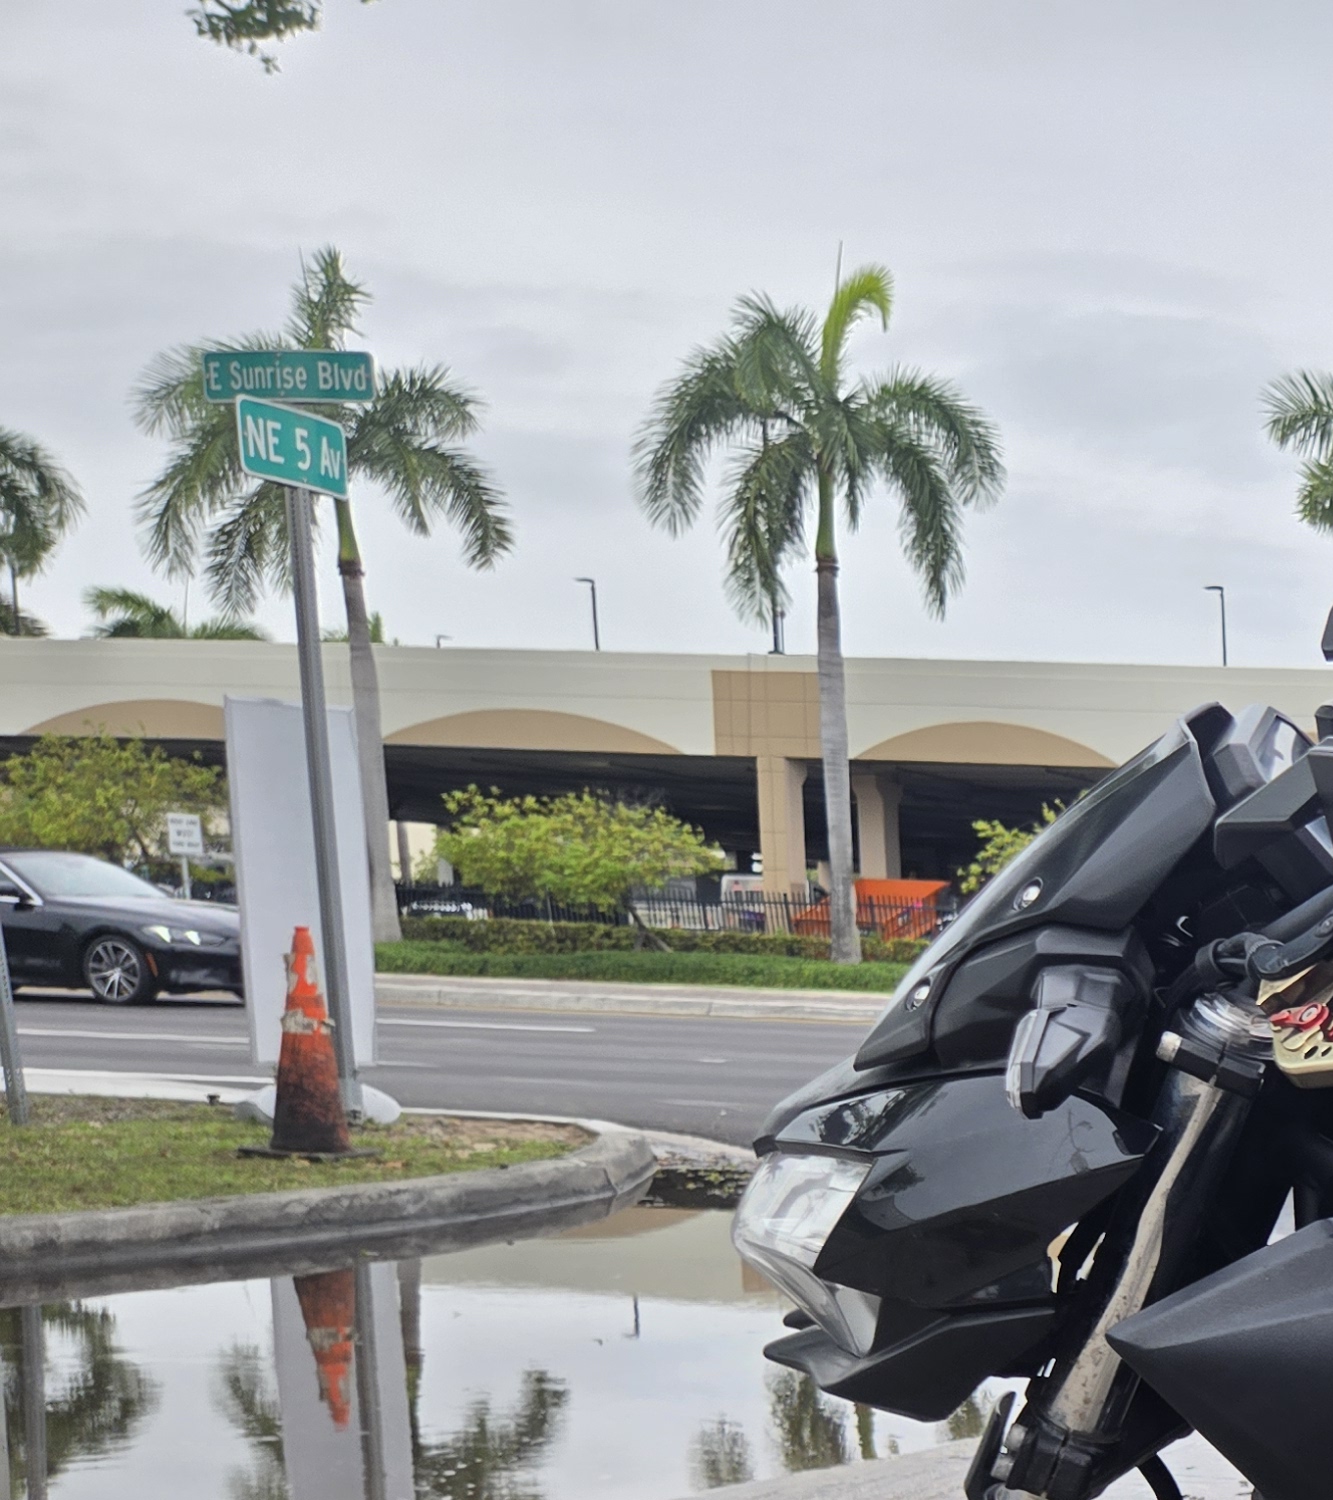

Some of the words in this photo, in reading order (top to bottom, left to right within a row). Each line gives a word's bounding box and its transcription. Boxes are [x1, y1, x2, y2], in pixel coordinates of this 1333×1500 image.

[208, 361, 222, 391] E
[230, 360, 308, 391] Sunrise
[317, 360, 367, 391] Blvd
[246, 415, 285, 465] NE
[295, 428, 311, 471] 5
